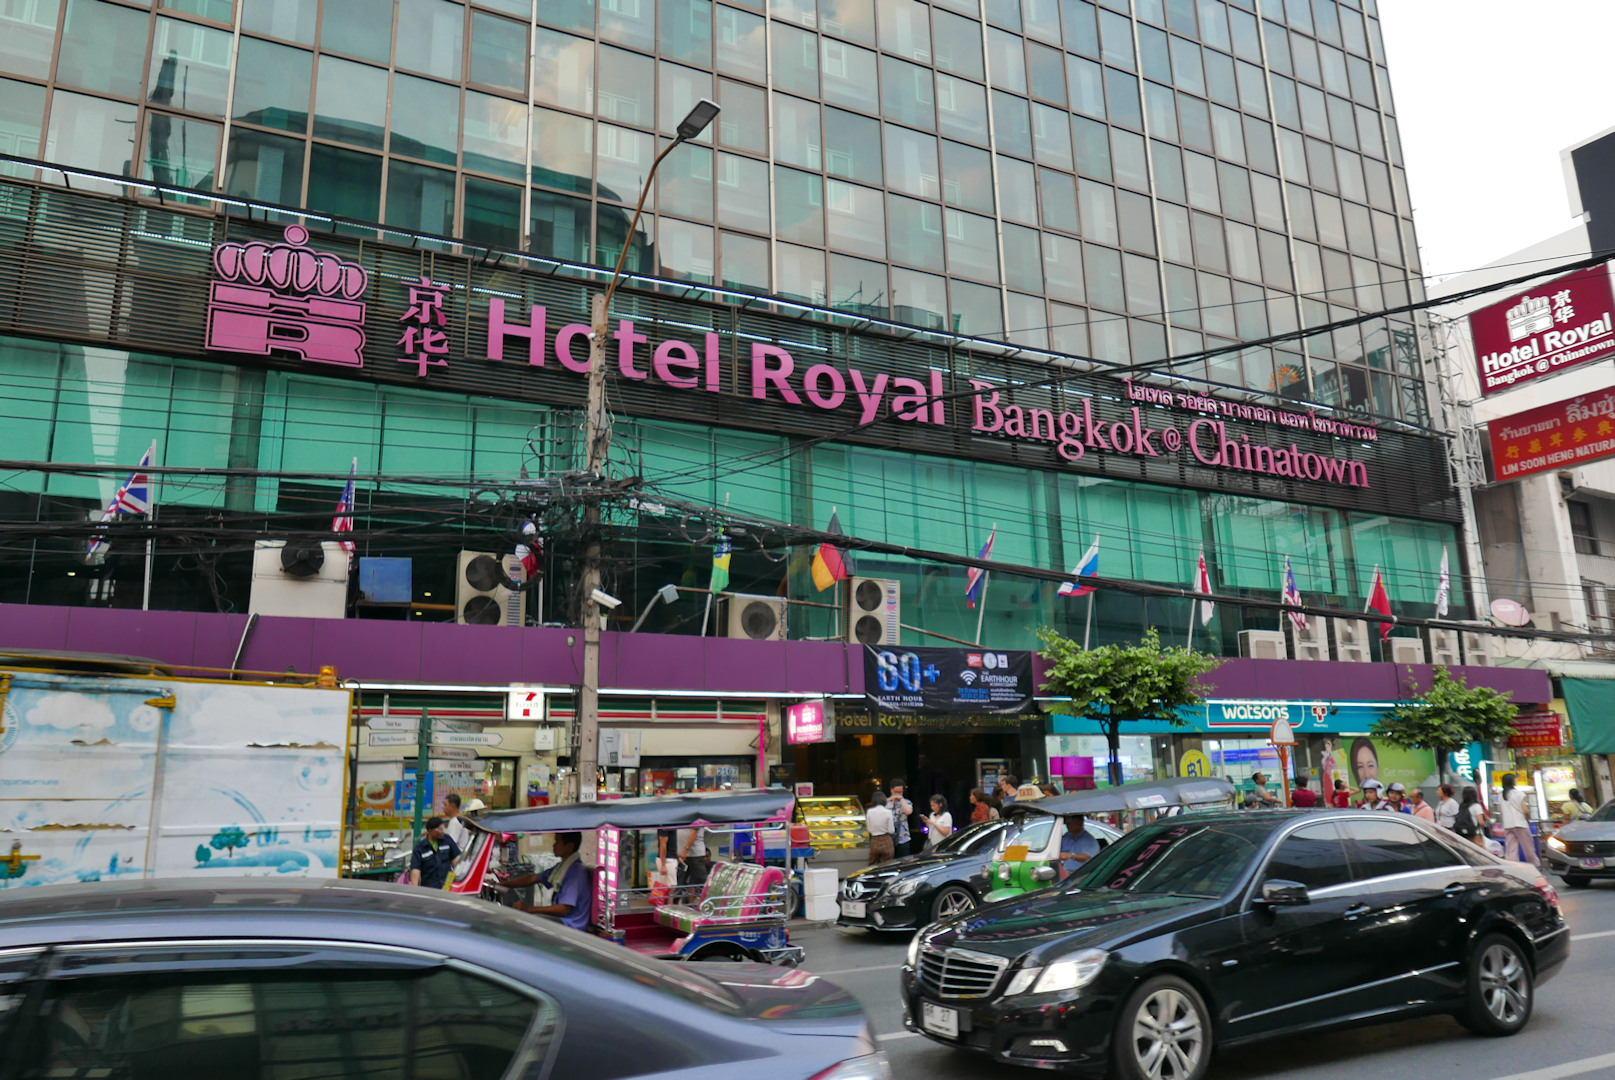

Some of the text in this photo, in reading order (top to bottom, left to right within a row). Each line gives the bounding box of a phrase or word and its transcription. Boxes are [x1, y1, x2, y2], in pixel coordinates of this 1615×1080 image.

[1551, 289, 1575, 324] 京华
[397, 276, 450, 378] 京华
[1482, 312, 1613, 374] Hotel Royal
[487, 298, 945, 426] Hotel Royal
[1486, 338, 1615, 388] Bangkok @ Chinatown
[967, 379, 1371, 488] Bangkok @ Chinatown
[1499, 418, 1561, 441] ร้านขายยา
[1502, 462, 1519, 476] LIM
[1520, 456, 1547, 471] SOON
[1547, 449, 1575, 465] HENG
[877, 650, 940, 692] 60+
[833, 712, 871, 726] Hotel
[1222, 704, 1289, 720] watsons
[1384, 767, 1395, 777] Get
